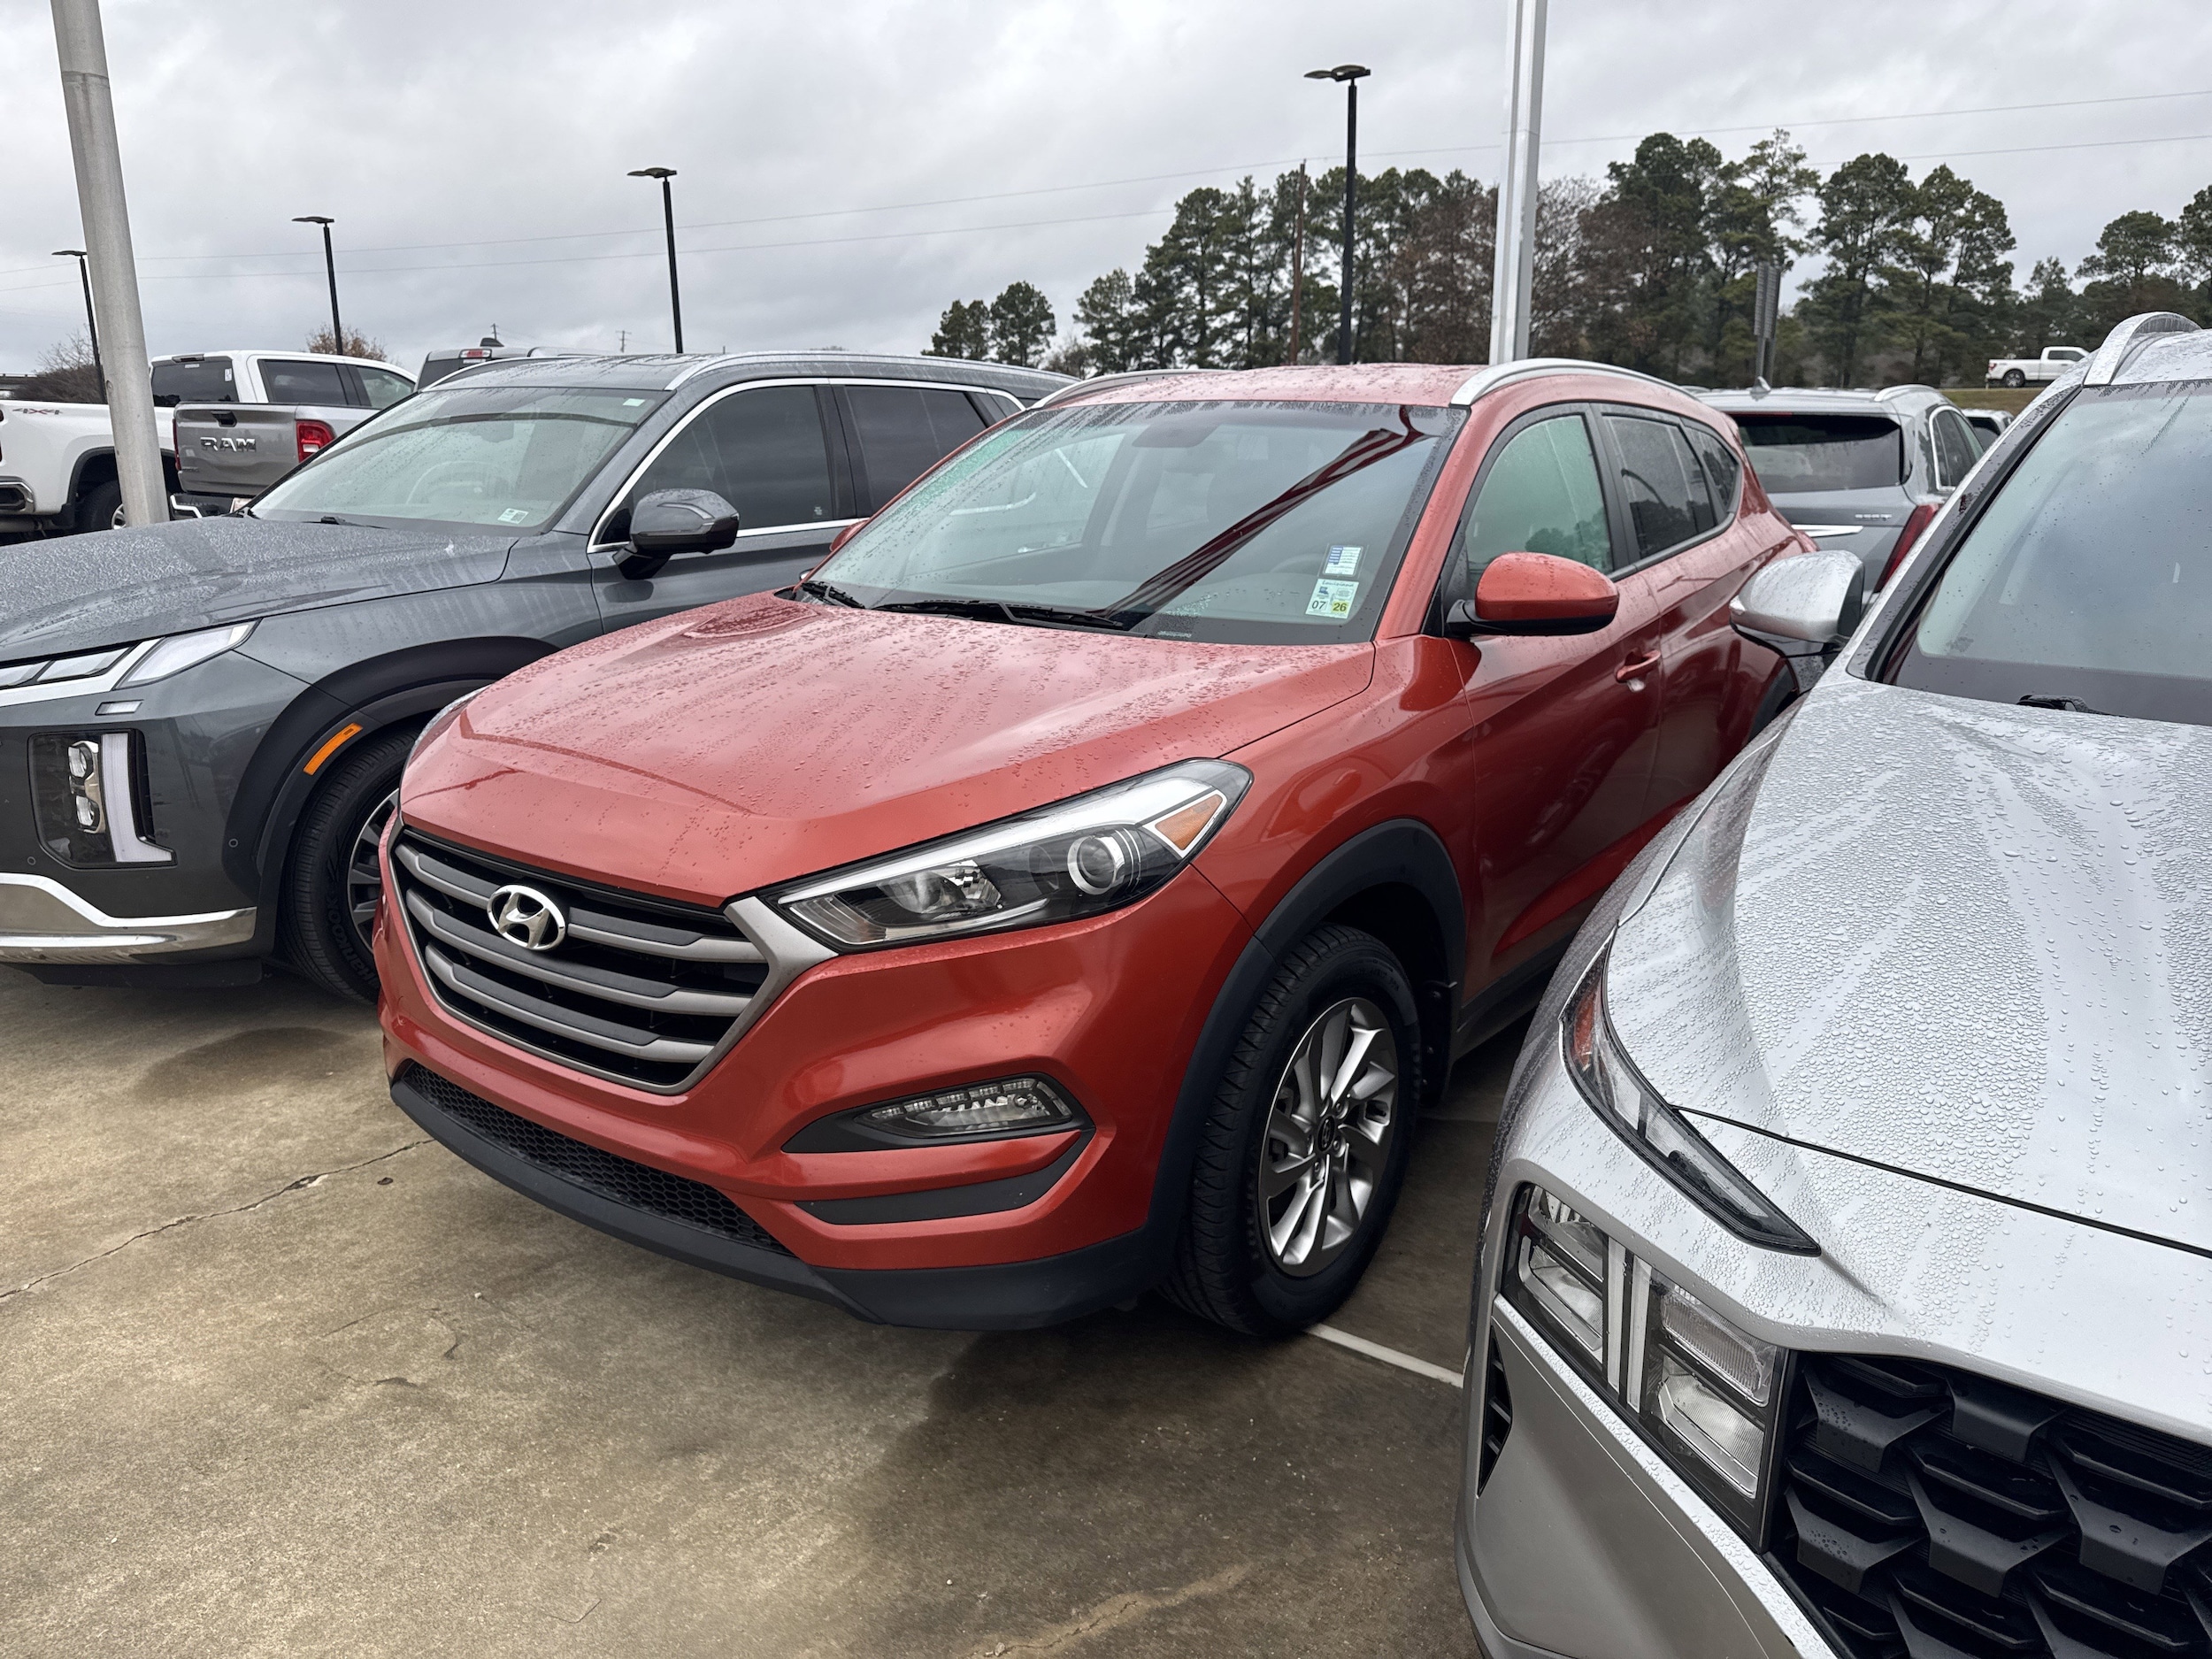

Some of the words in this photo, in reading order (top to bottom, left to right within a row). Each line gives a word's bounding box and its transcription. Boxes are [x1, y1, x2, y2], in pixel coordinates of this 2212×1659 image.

[200, 436, 257, 452] RAM
[1311, 601, 1326, 610] 07
[1333, 603, 1347, 611] 26
